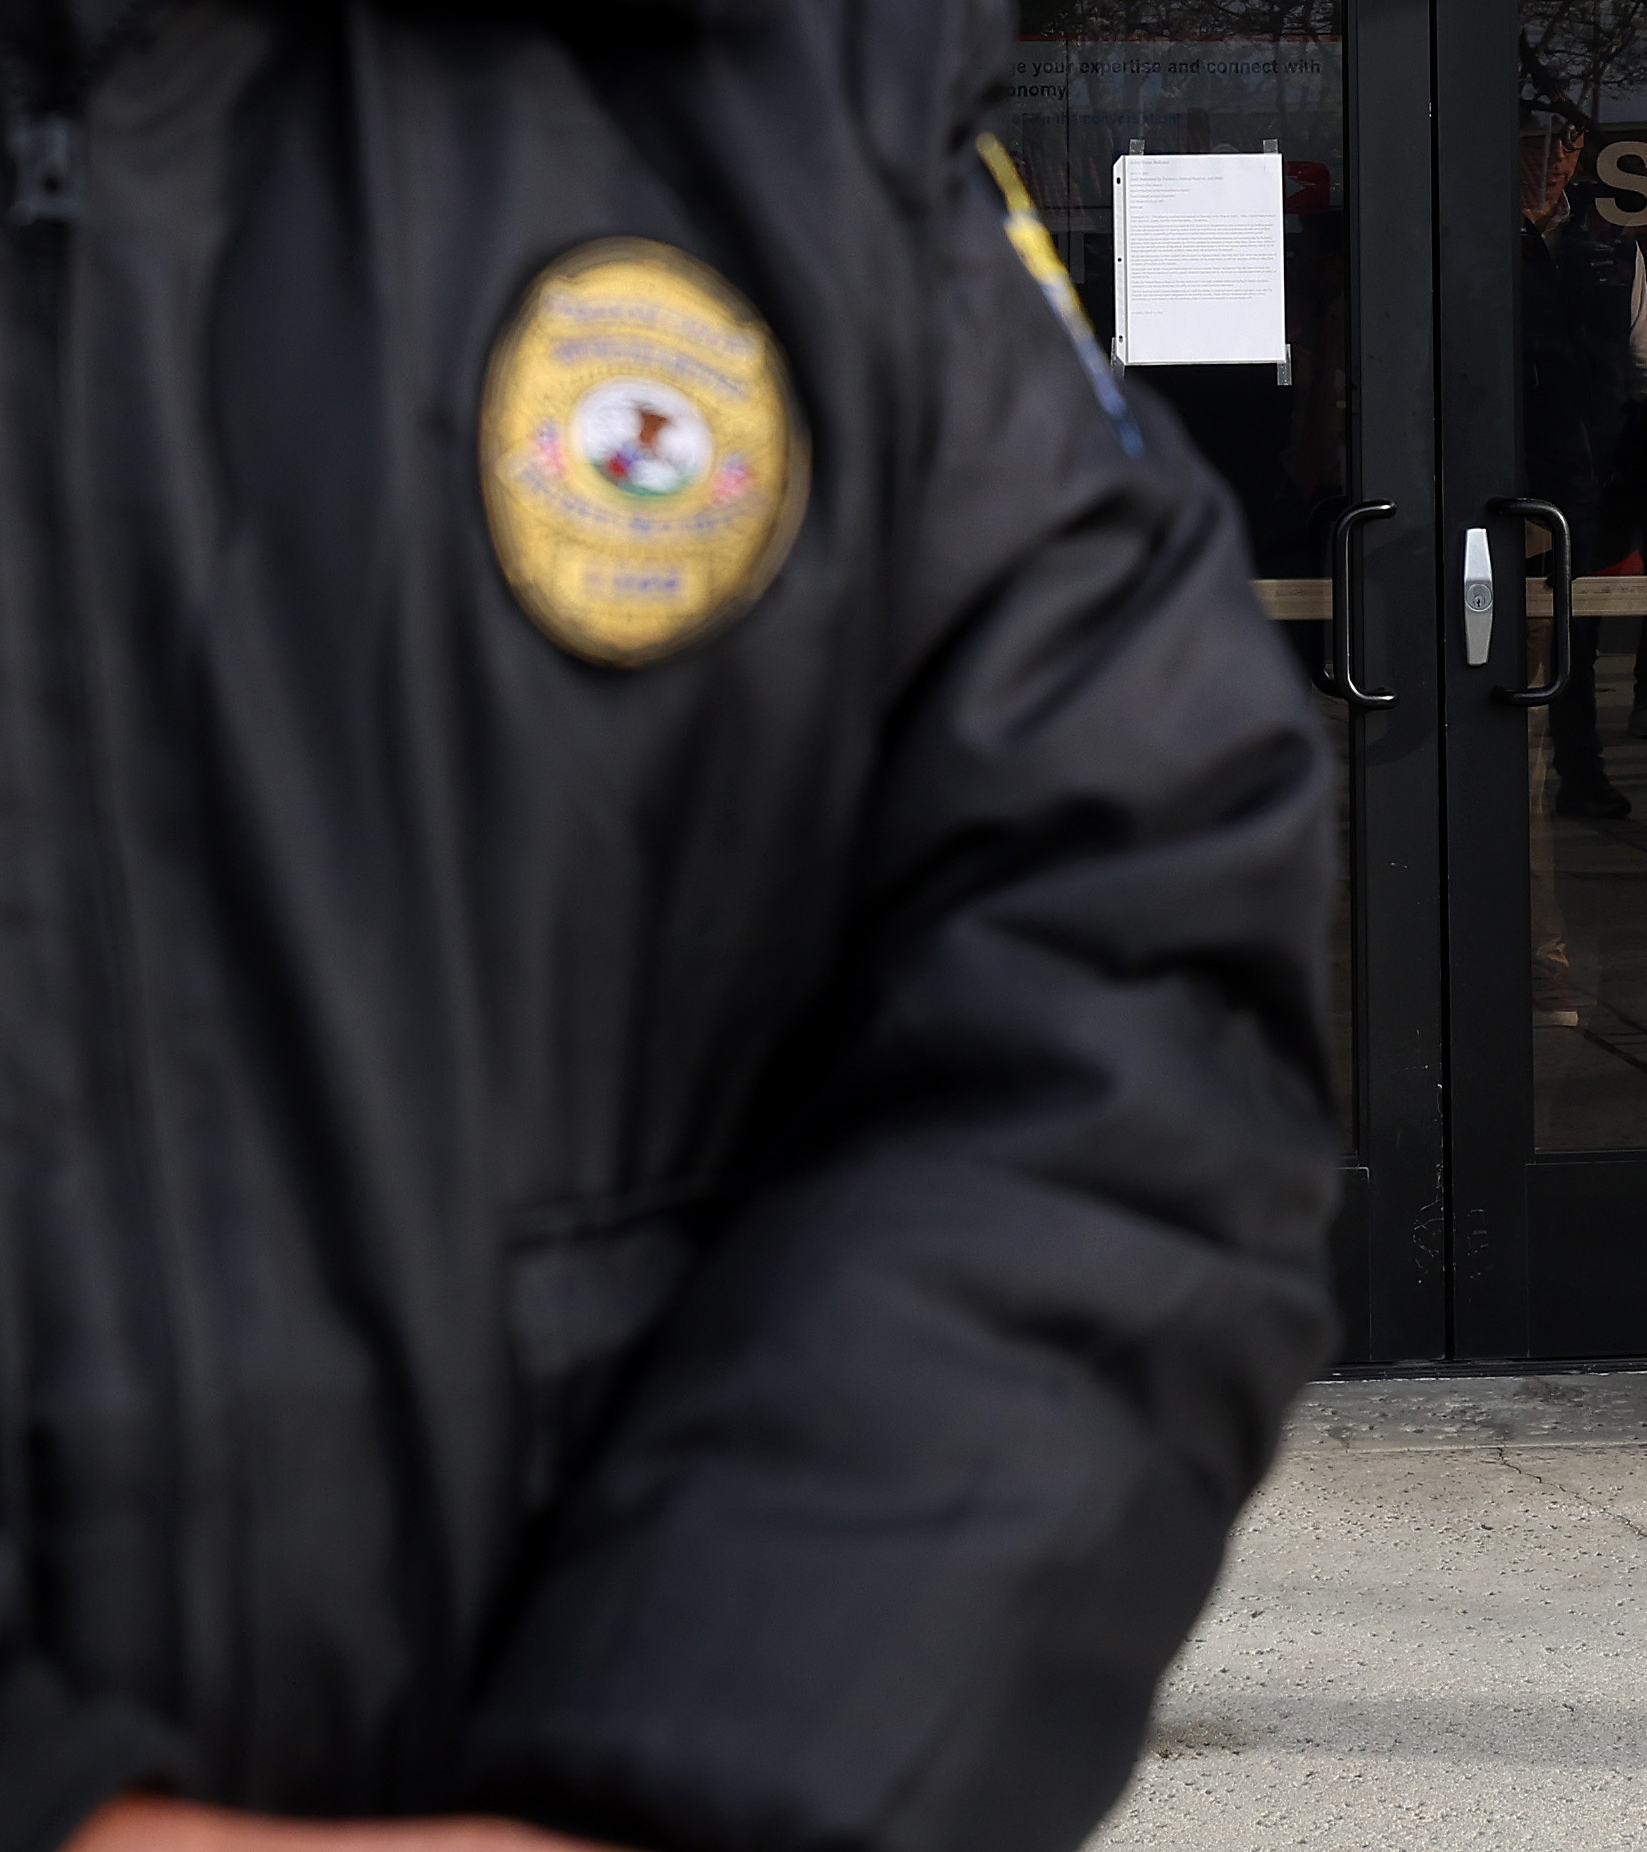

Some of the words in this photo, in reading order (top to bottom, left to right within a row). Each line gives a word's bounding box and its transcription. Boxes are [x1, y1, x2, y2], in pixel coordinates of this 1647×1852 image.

[1079, 59, 1161, 77] expertise
[1168, 59, 1200, 74] and
[1207, 59, 1278, 74] connect
[1284, 58, 1321, 74] with
